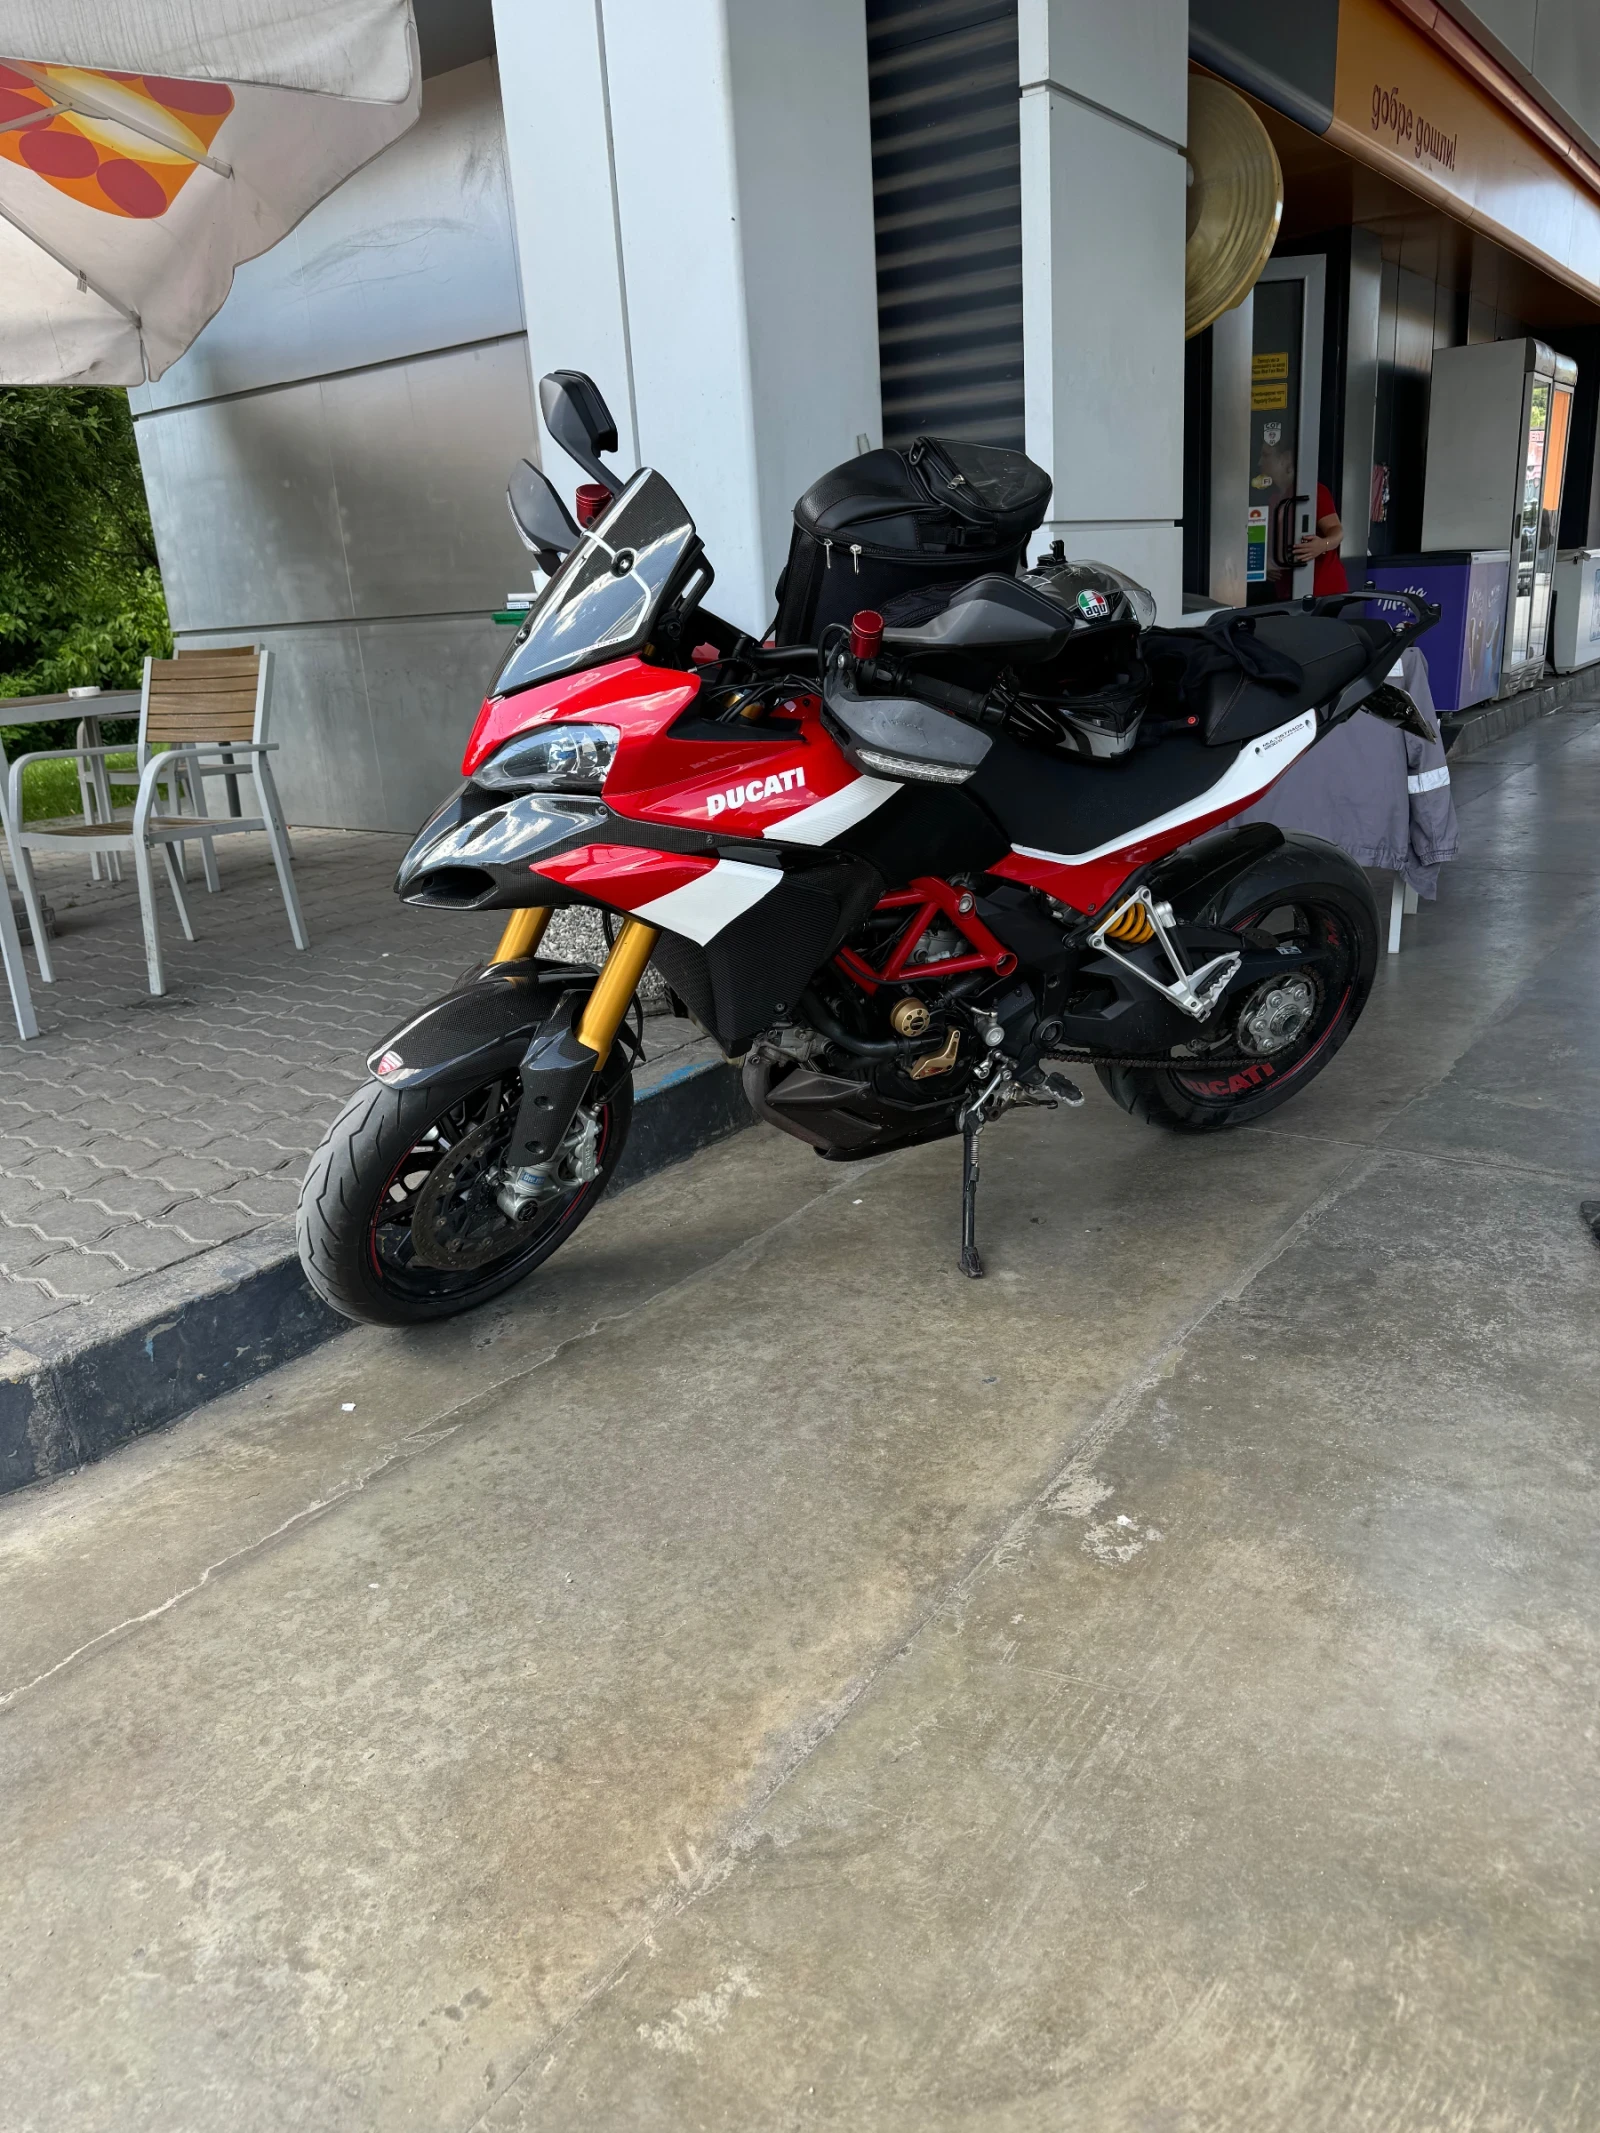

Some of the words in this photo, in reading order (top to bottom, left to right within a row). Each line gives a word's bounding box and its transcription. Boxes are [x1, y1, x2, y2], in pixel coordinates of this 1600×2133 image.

[1371, 84, 1413, 144] добре
[1414, 116, 1458, 172] дошли!
[706, 766, 806, 817] DUCATI
